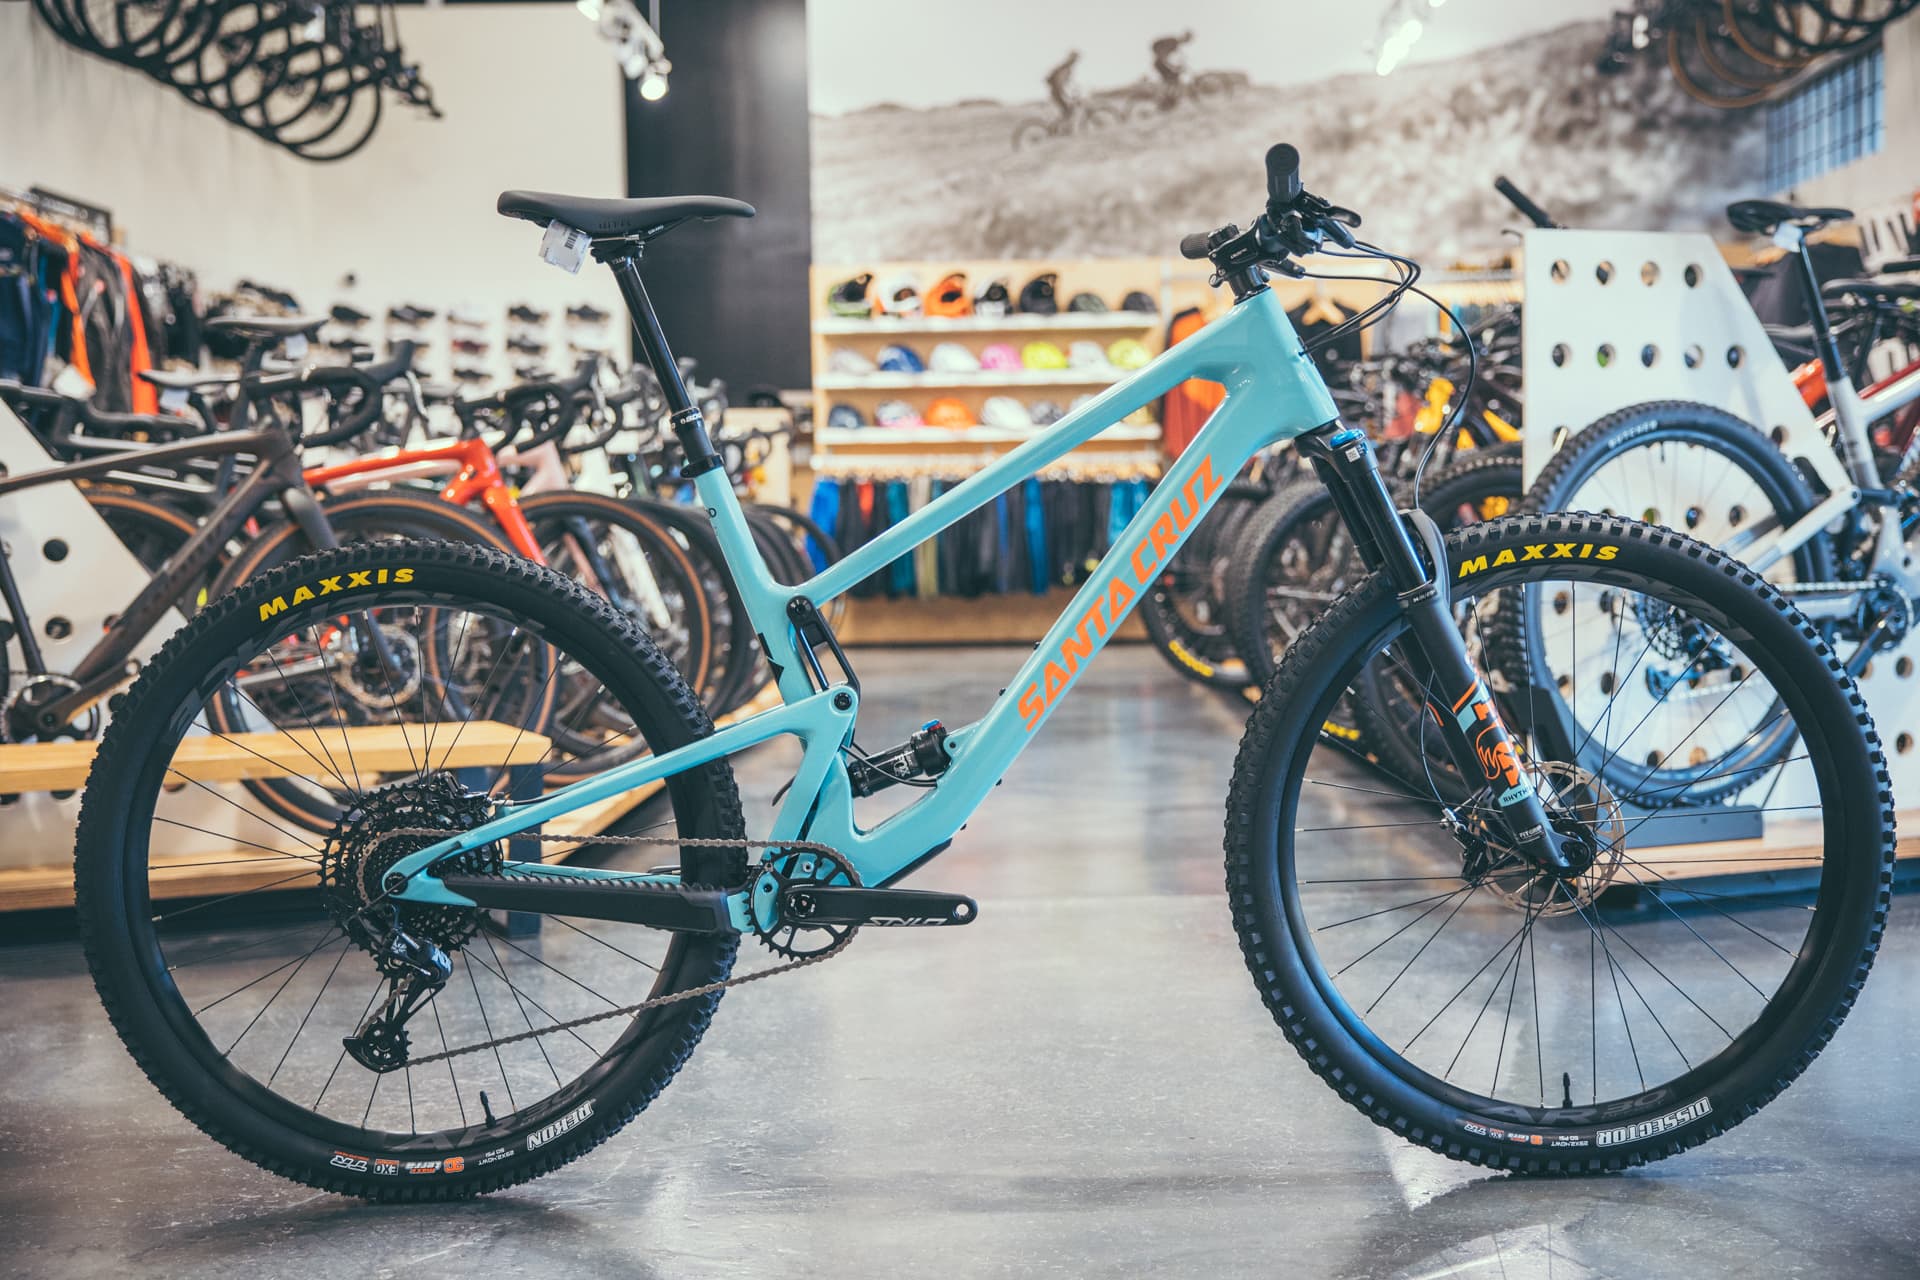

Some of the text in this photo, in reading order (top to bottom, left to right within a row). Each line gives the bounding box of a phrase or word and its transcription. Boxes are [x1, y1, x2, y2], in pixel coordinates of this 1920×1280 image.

[1459, 543, 1619, 578] MAXXIS
[259, 568, 415, 621] MAXXIS
[1017, 577, 1137, 731] SANTA
[1130, 454, 1223, 586] CRUZ
[893, 754, 911, 777] FOX
[527, 1098, 596, 1151] REKON
[1594, 1096, 1713, 1147] DISSECTOR
[374, 1163, 399, 1176] EXO
[443, 1156, 465, 1174] 3C
